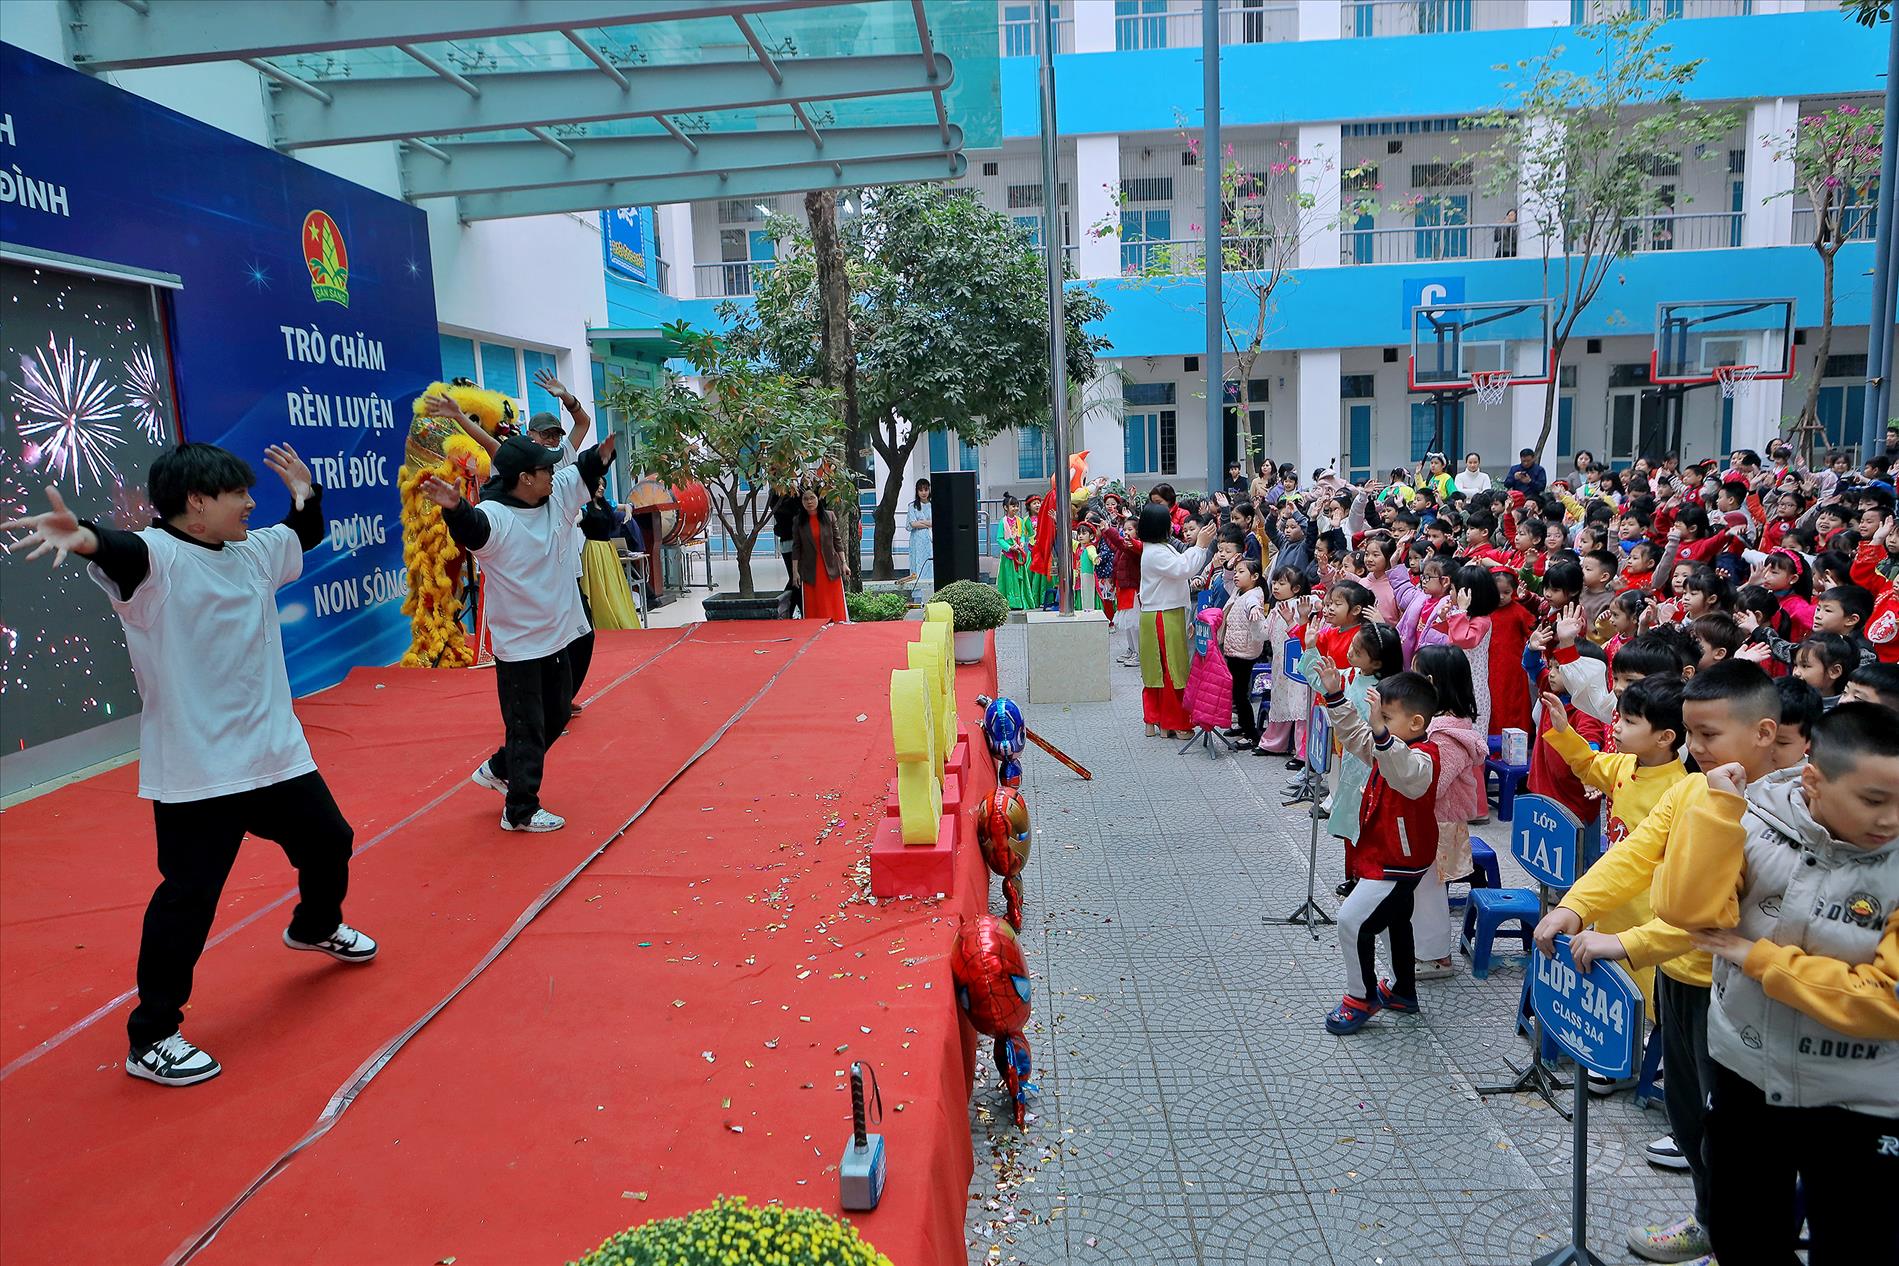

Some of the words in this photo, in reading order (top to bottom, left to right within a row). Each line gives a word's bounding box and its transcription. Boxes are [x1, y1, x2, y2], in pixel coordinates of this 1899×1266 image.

[0, 164, 70, 217] ĐÌNH
[1421, 284, 1446, 319] C
[280, 323, 326, 365] TRÒ
[330, 331, 386, 372] CHĂM
[287, 386, 332, 428] RÈN
[338, 392, 395, 437] LUYỆN
[311, 451, 347, 490] TRÍ
[350, 451, 389, 488] ĐỨC
[330, 513, 386, 557] DỰNG
[313, 577, 359, 618] NON
[1533, 810, 1557, 833] LỚP
[1520, 829, 1564, 881] 1A1
[1538, 950, 1576, 999] LỚP
[1581, 977, 1624, 1035] 3A4
[1552, 1000, 1582, 1030] CLASS
[1584, 1021, 1604, 1046] 3A4
[1799, 1036, 1880, 1060] G.DUCK
